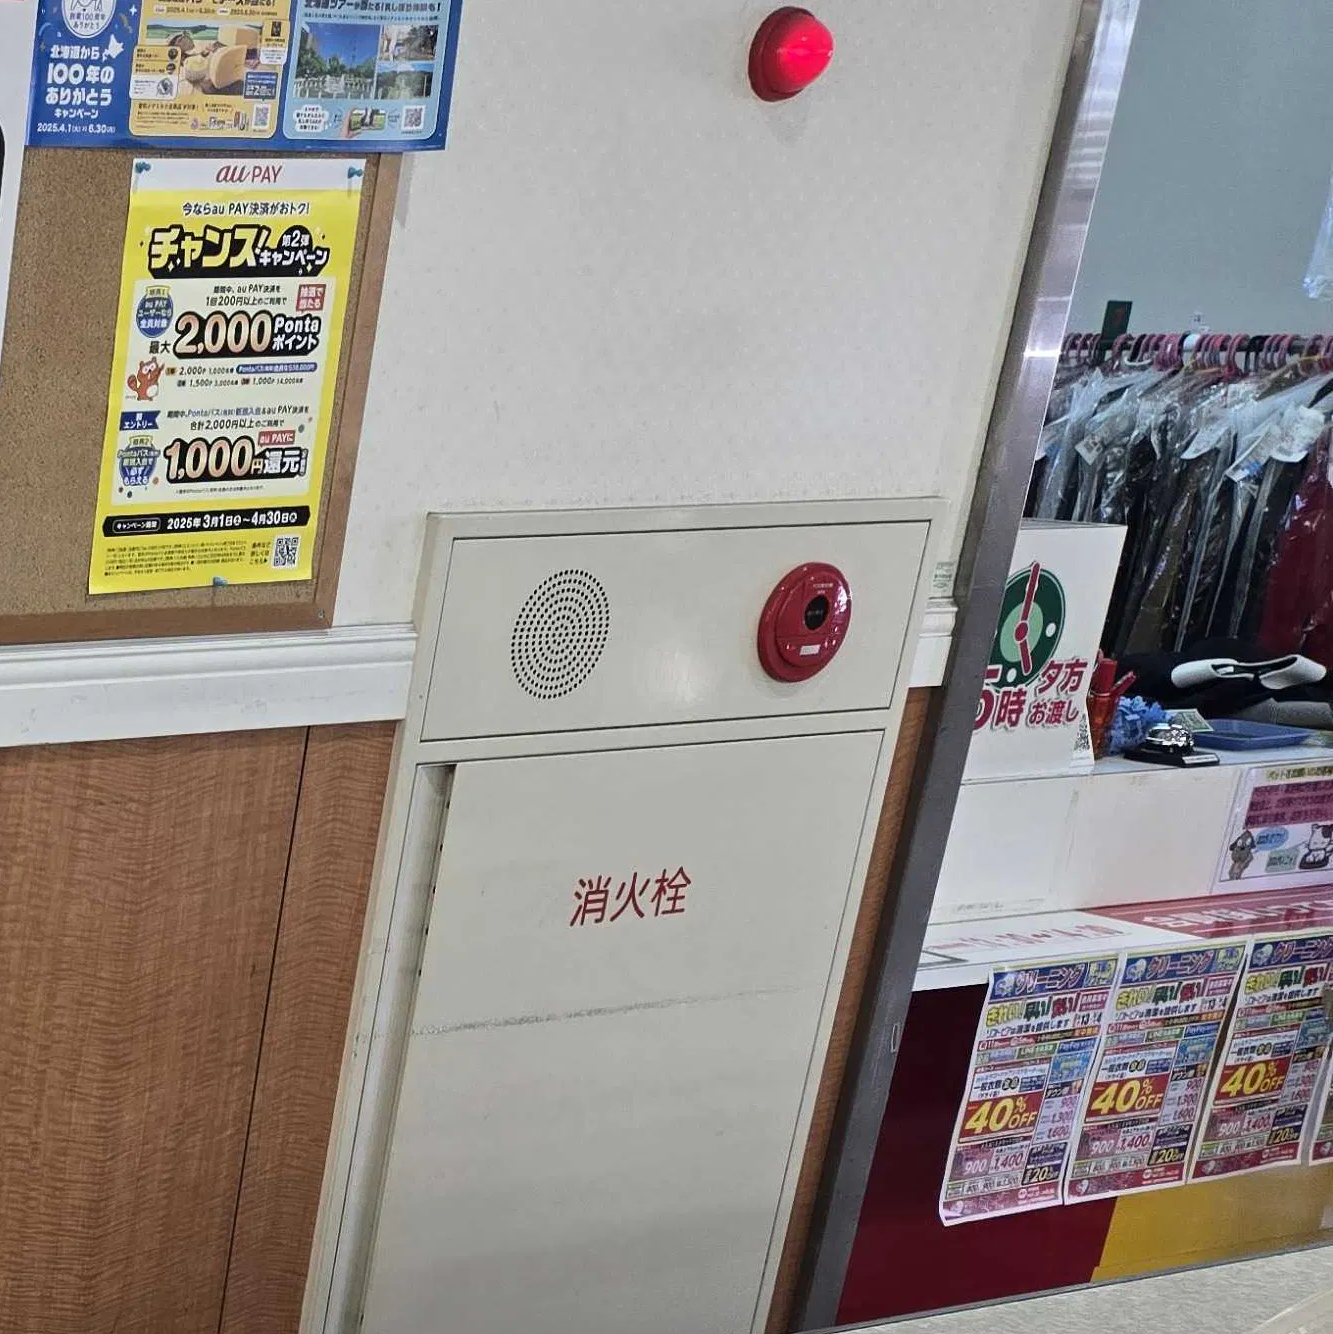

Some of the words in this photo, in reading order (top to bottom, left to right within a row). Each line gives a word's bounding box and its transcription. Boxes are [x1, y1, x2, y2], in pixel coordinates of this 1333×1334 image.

[50, 45, 100, 60] 北海道から
[47, 63, 114, 84] 100年の
[46, 87, 112, 106] ありがとう
[54, 108, 99, 118] キャンペーン
[251, 165, 283, 183] PAY
[259, 250, 329, 267] キャンペーン
[176, 312, 272, 354] 2,000
[275, 316, 320, 332] Ponta
[273, 333, 319, 350] ポイント
[1038, 658, 1088, 694] 夕方
[1028, 699, 1080, 728] お渡し
[570, 866, 692, 927] 消火栓
[1260, 1076, 1284, 1092] OFF
[1135, 1093, 1164, 1109] OFF
[1008, 1111, 1037, 1129] OFF
